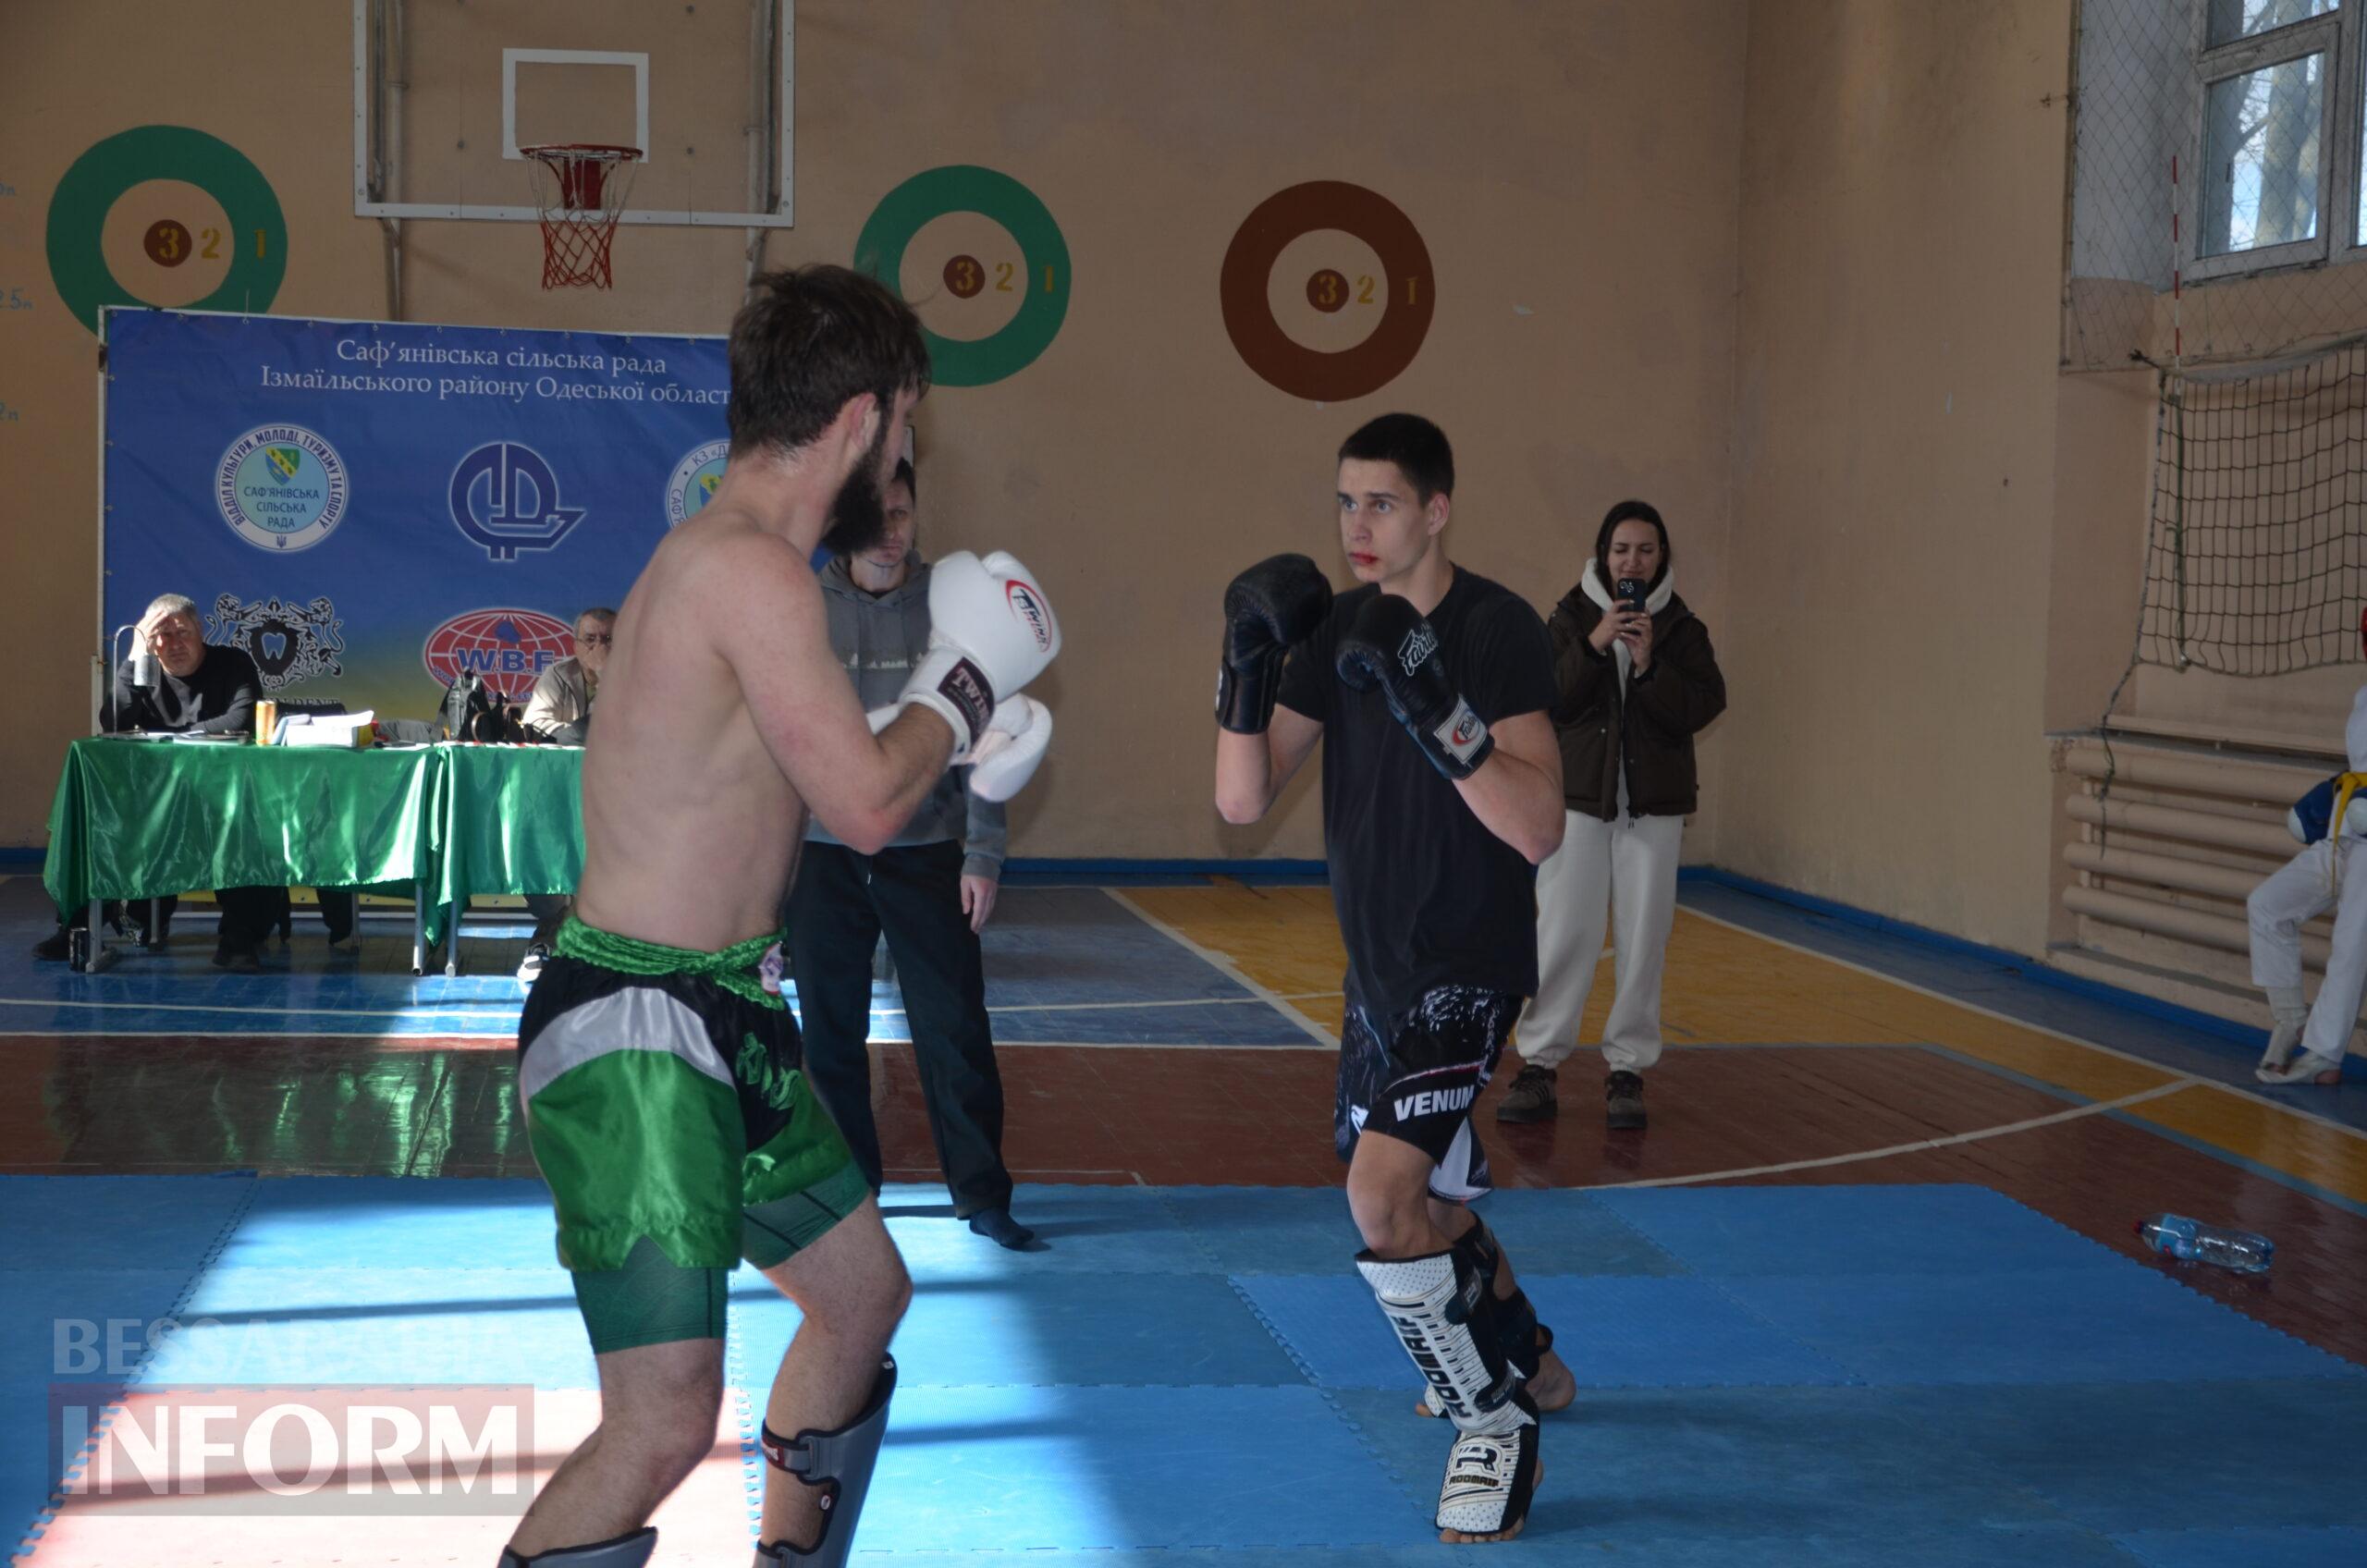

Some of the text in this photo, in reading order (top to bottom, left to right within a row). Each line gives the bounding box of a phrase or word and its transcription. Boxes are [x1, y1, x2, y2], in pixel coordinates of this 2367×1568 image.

[158, 227, 267, 259] 3 2 1
[955, 262, 1054, 293] 3 2 1
[1318, 275, 1418, 305] 3 2 1
[337, 339, 666, 377] Саф’янівська сільська рада
[261, 365, 731, 404] Ізмаїльського району Одеської област
[302, 435, 339, 474] ТУРИЗМУ
[243, 486, 320, 500] САФ'ЯНІВСЬКА
[330, 476, 343, 489] ТА
[222, 490, 246, 526] ВІДДІЛ
[256, 501, 307, 514] СІЛЬСЬКА
[267, 517, 296, 530] РАДА
[318, 492, 343, 530] СПОРТУ
[1393, 1084, 1476, 1121] VENUM
